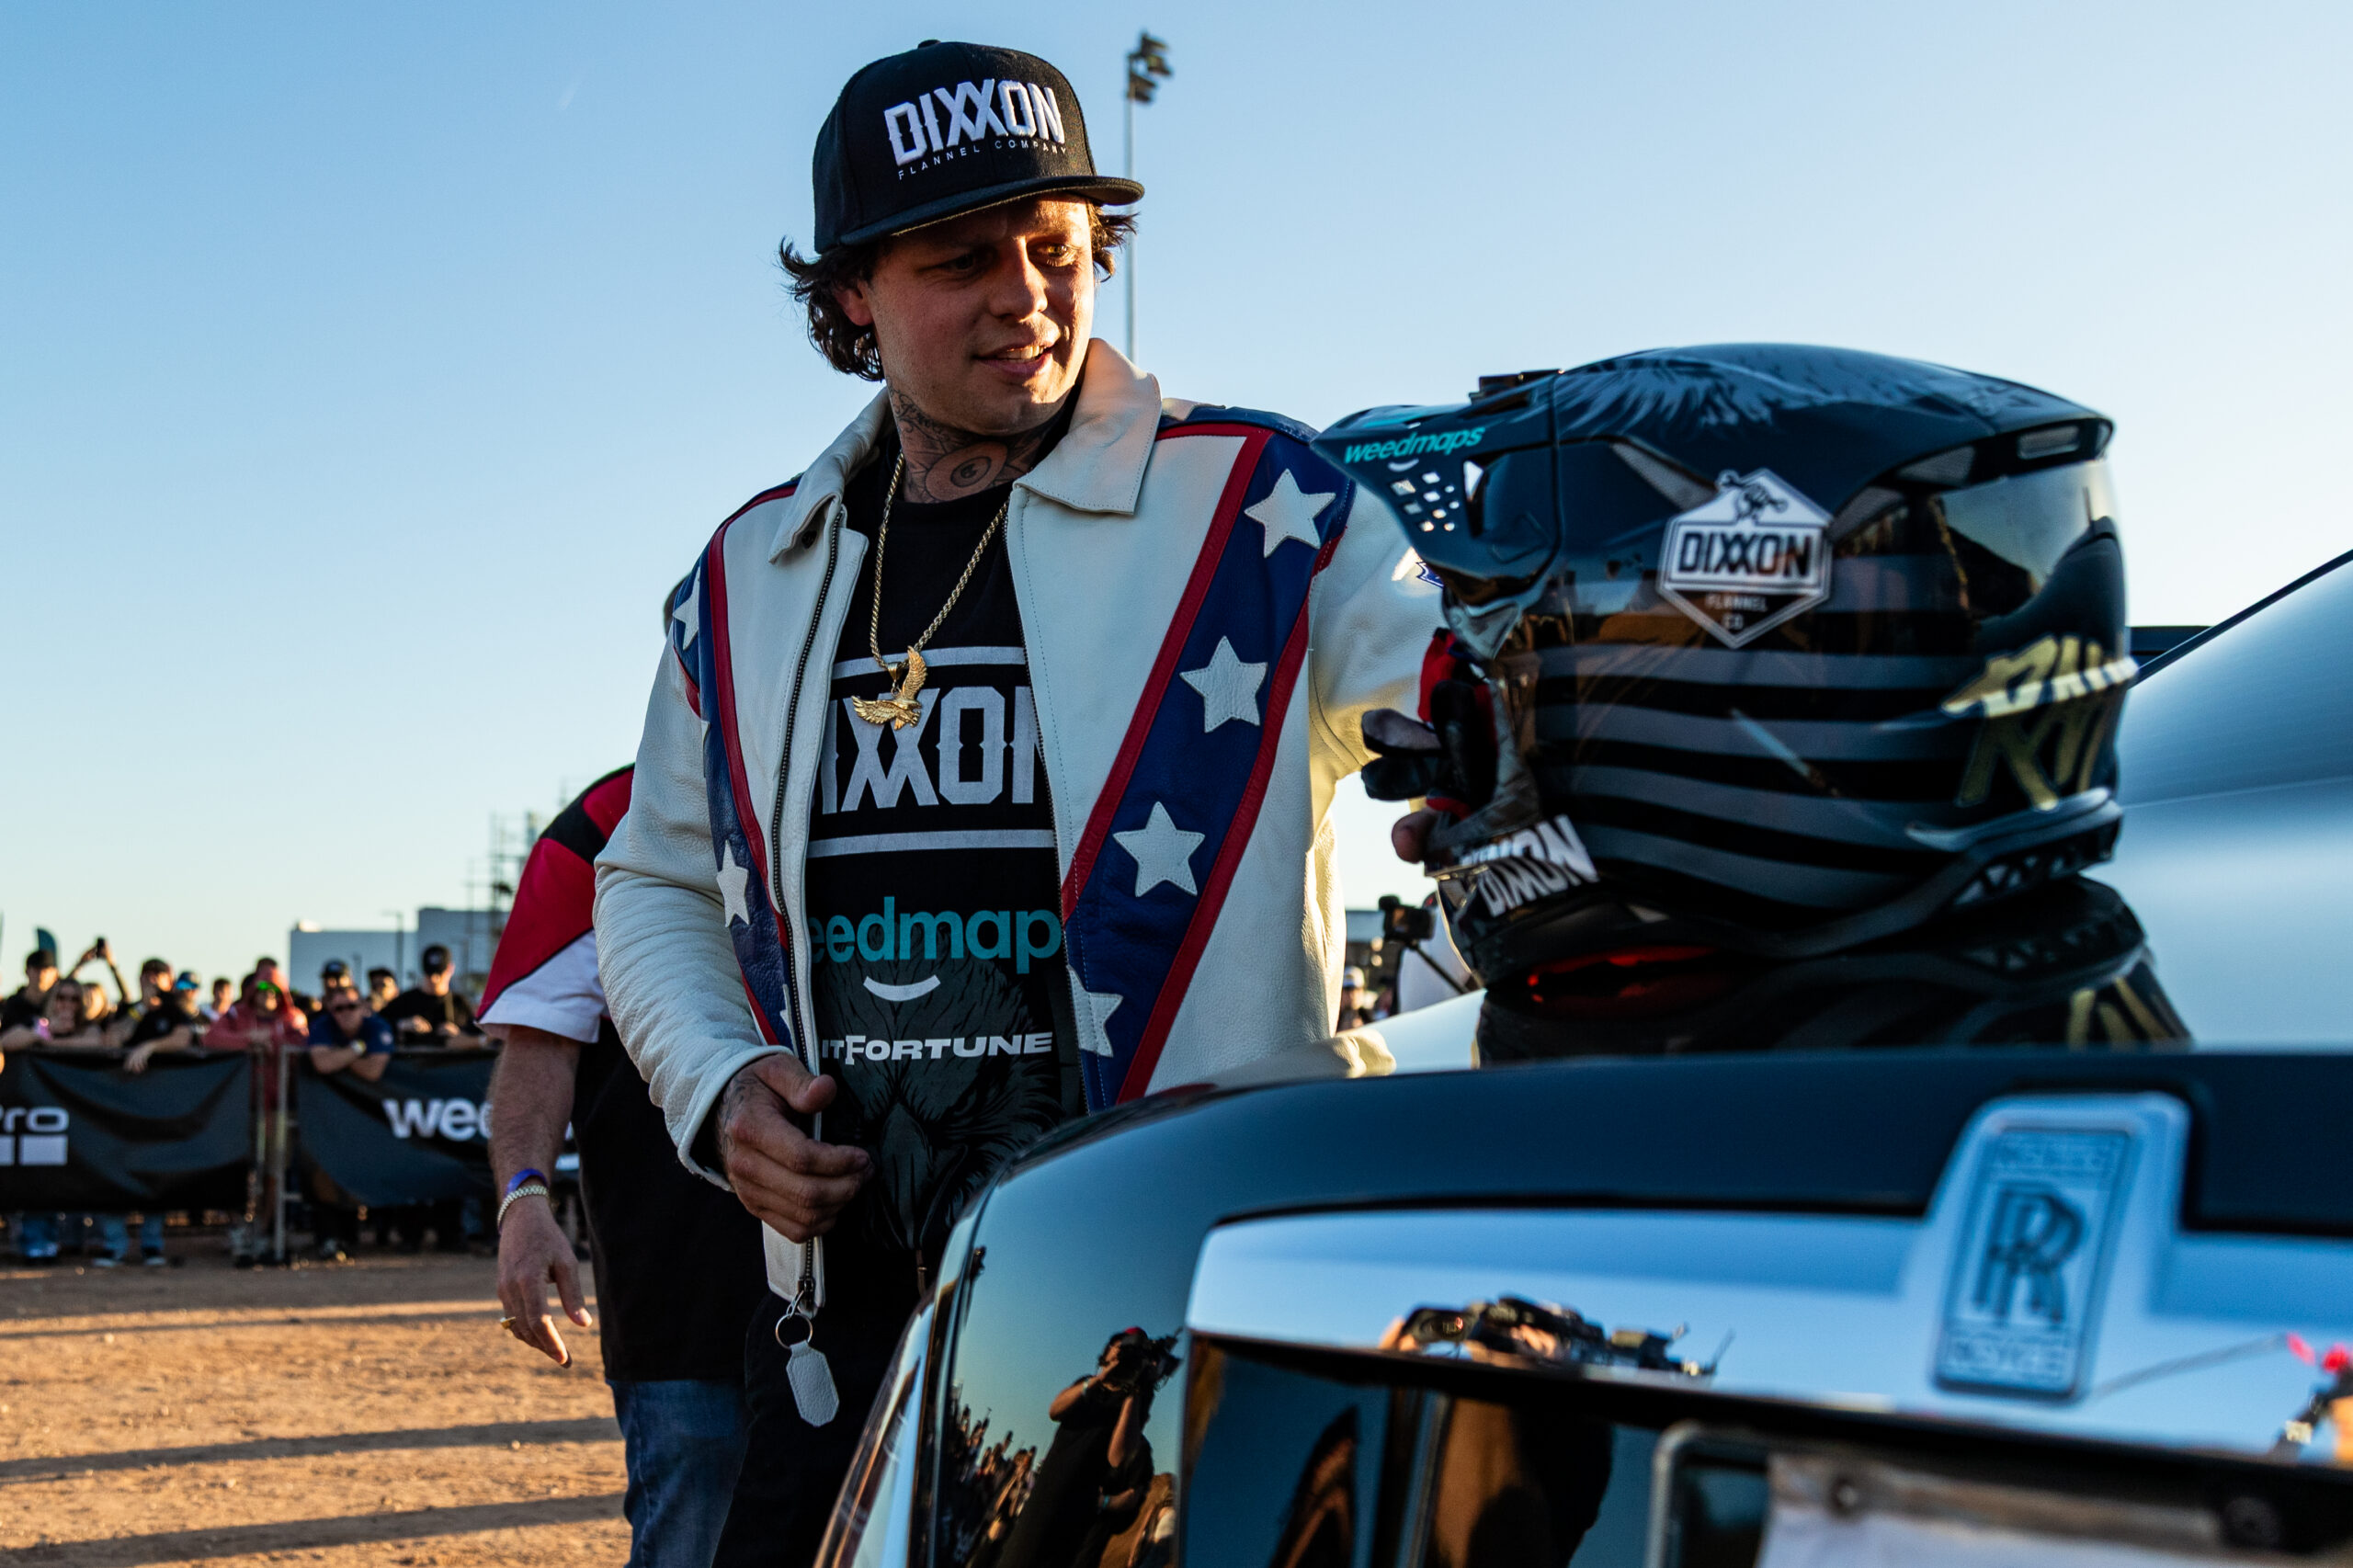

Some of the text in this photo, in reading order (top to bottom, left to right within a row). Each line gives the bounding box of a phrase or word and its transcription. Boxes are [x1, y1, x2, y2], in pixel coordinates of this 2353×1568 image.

[883, 78, 1066, 166] DIXXON
[897, 139, 1067, 181] FLANNEL COMPANY
[1344, 426, 1486, 464] weedmaps
[1677, 531, 1812, 578] DIXXON
[0, 1104, 70, 1133] ro
